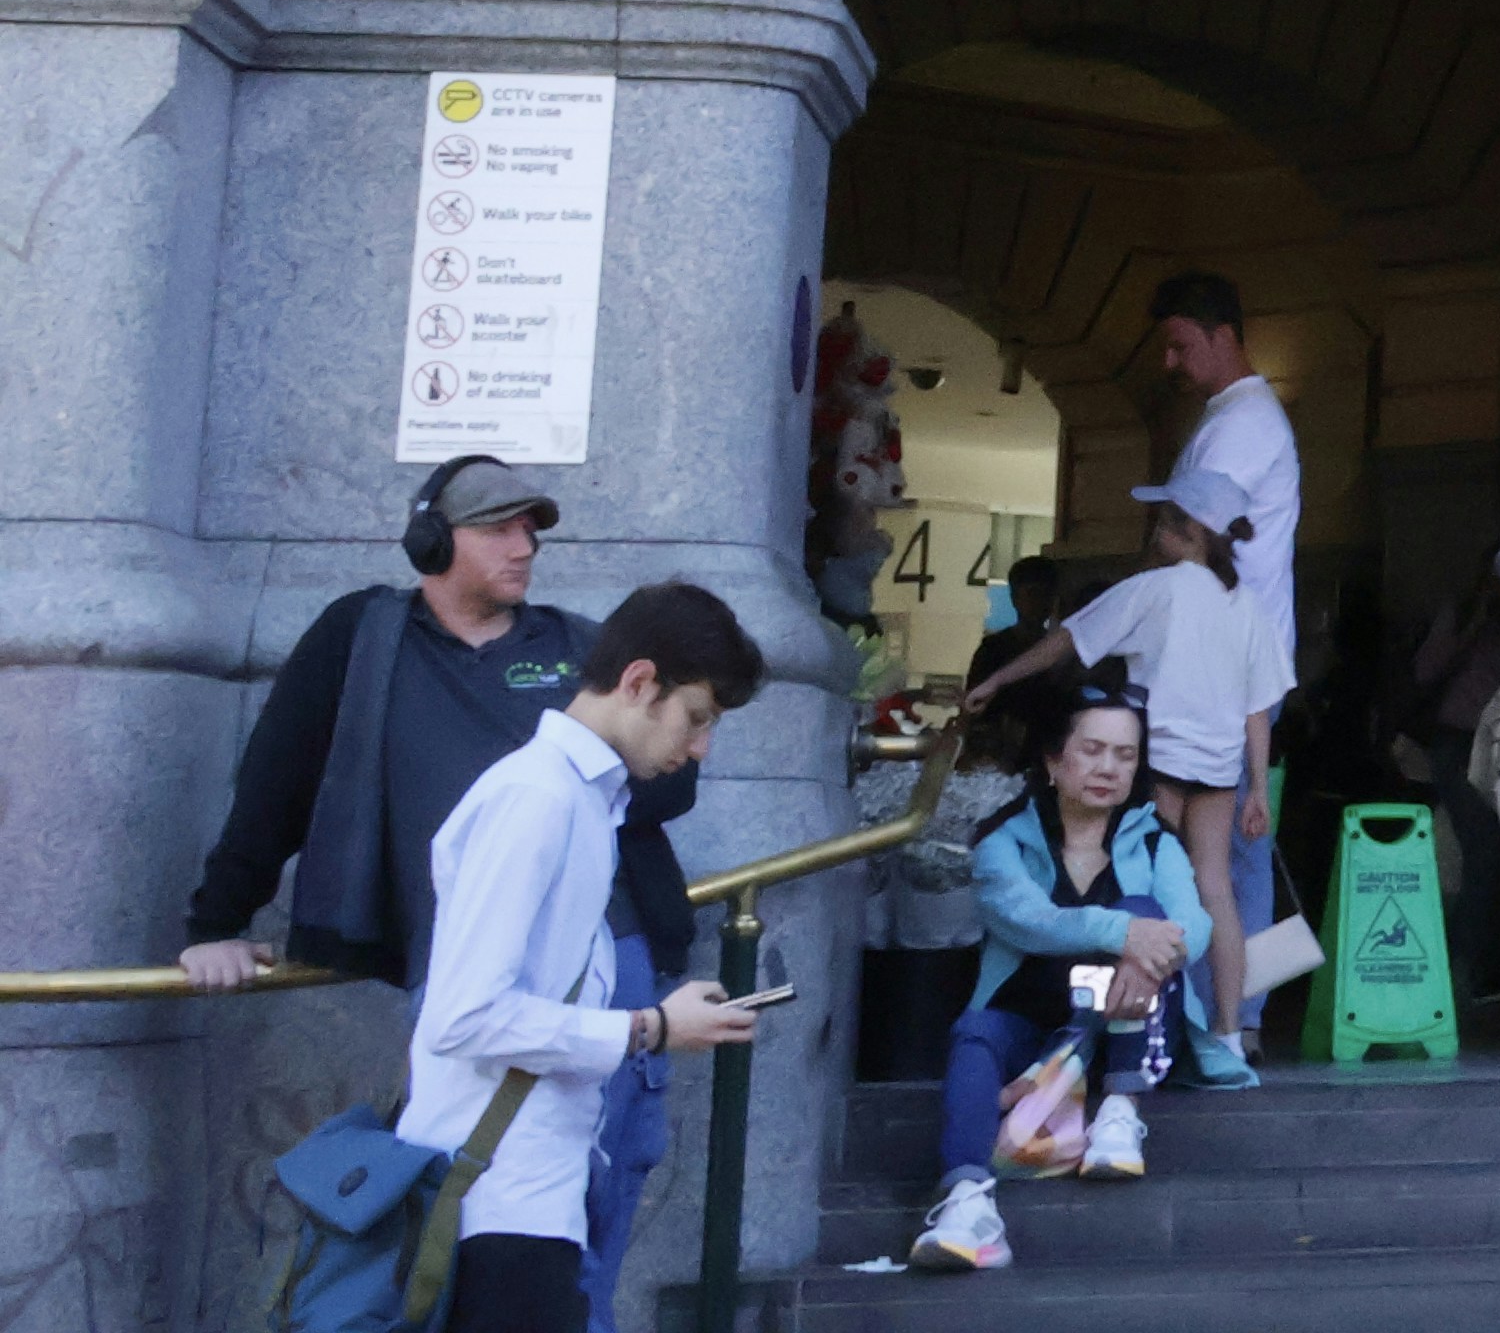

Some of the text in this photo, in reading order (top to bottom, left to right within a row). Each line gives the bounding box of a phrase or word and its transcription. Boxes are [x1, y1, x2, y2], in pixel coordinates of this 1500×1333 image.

[491, 88, 603, 104] CCTV cameras
[536, 107, 562, 118] use
[487, 144, 574, 161] No smoking
[486, 159, 558, 177] No vaping
[482, 208, 593, 226] Walk your bike
[477, 255, 516, 270] Don't
[476, 272, 563, 286] skateboard
[473, 313, 549, 329] Walk your
[471, 329, 528, 343] scooter
[467, 370, 552, 386] No drinking
[466, 385, 542, 400] of alcohol
